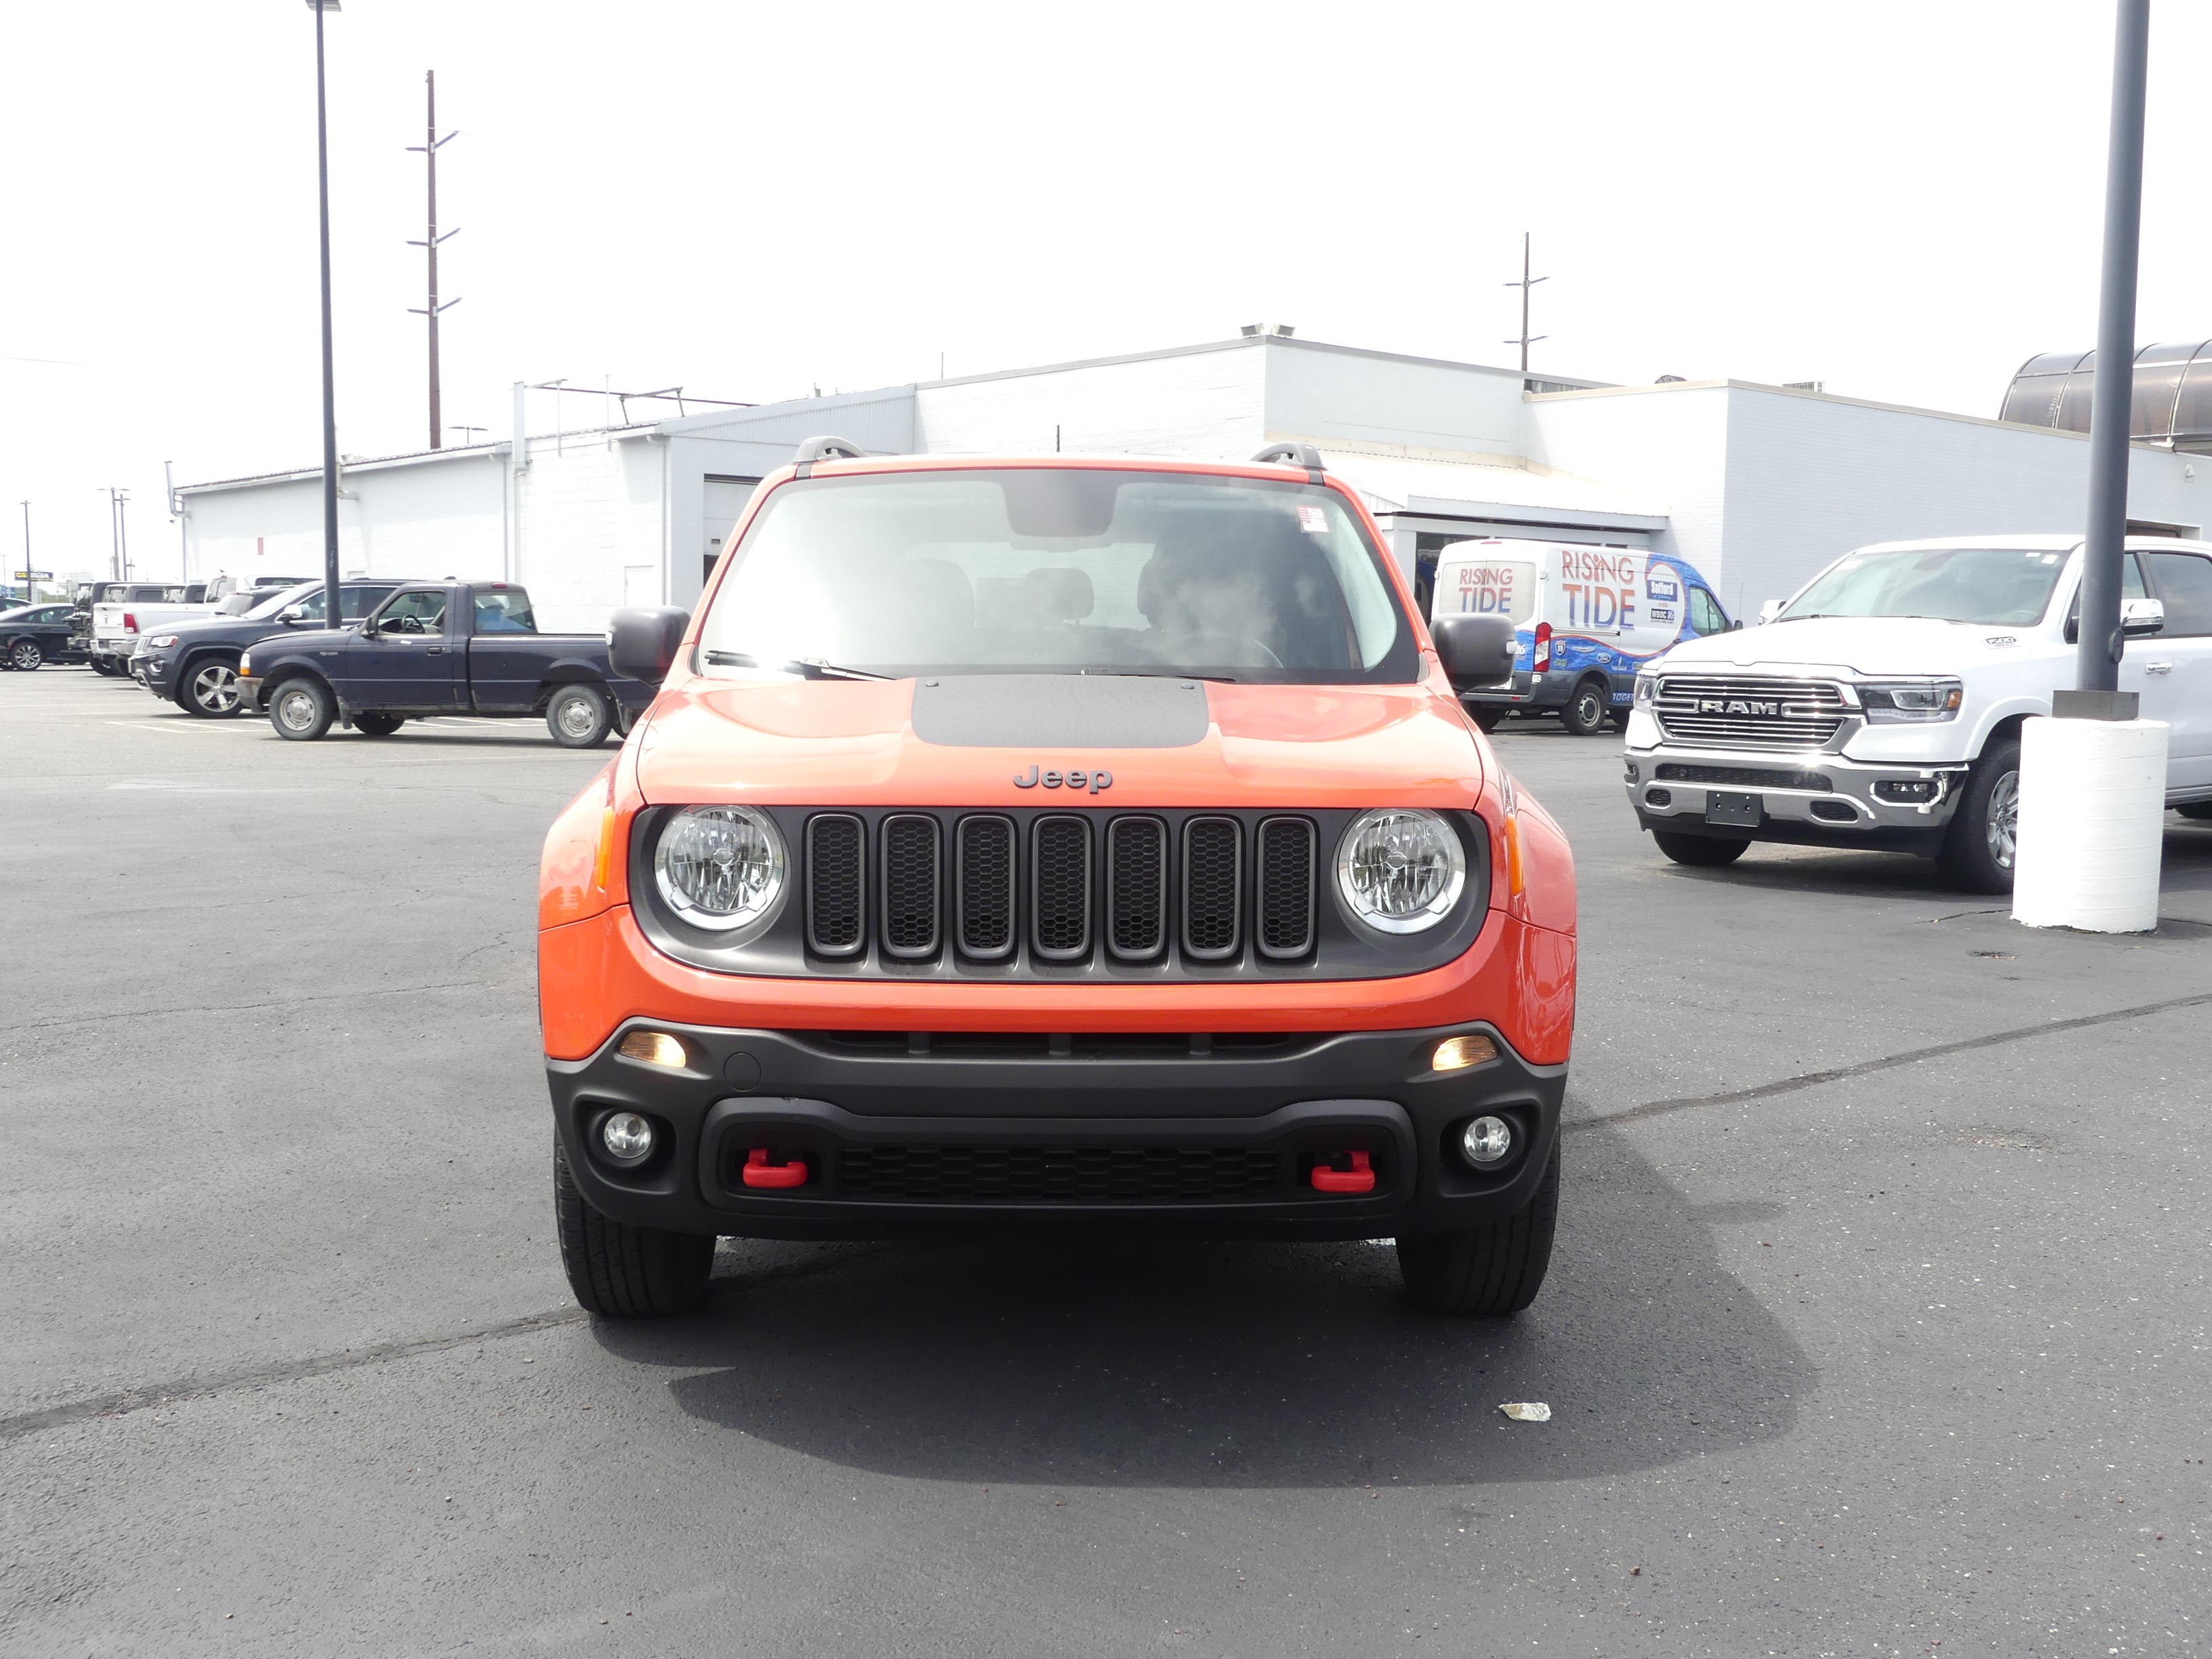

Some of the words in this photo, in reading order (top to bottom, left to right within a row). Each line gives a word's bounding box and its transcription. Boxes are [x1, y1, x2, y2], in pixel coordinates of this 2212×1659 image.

[1460, 568, 1513, 586] RISING
[1562, 550, 1634, 585] RISING
[1651, 581, 1673, 595] Safford
[1459, 587, 1512, 613] TIDE
[1562, 583, 1635, 631] TIDE
[1651, 610, 1667, 619] WBOC
[1667, 611, 1674, 619] 16
[1701, 700, 1778, 715] RAM
[1013, 764, 1113, 795] Jeep
